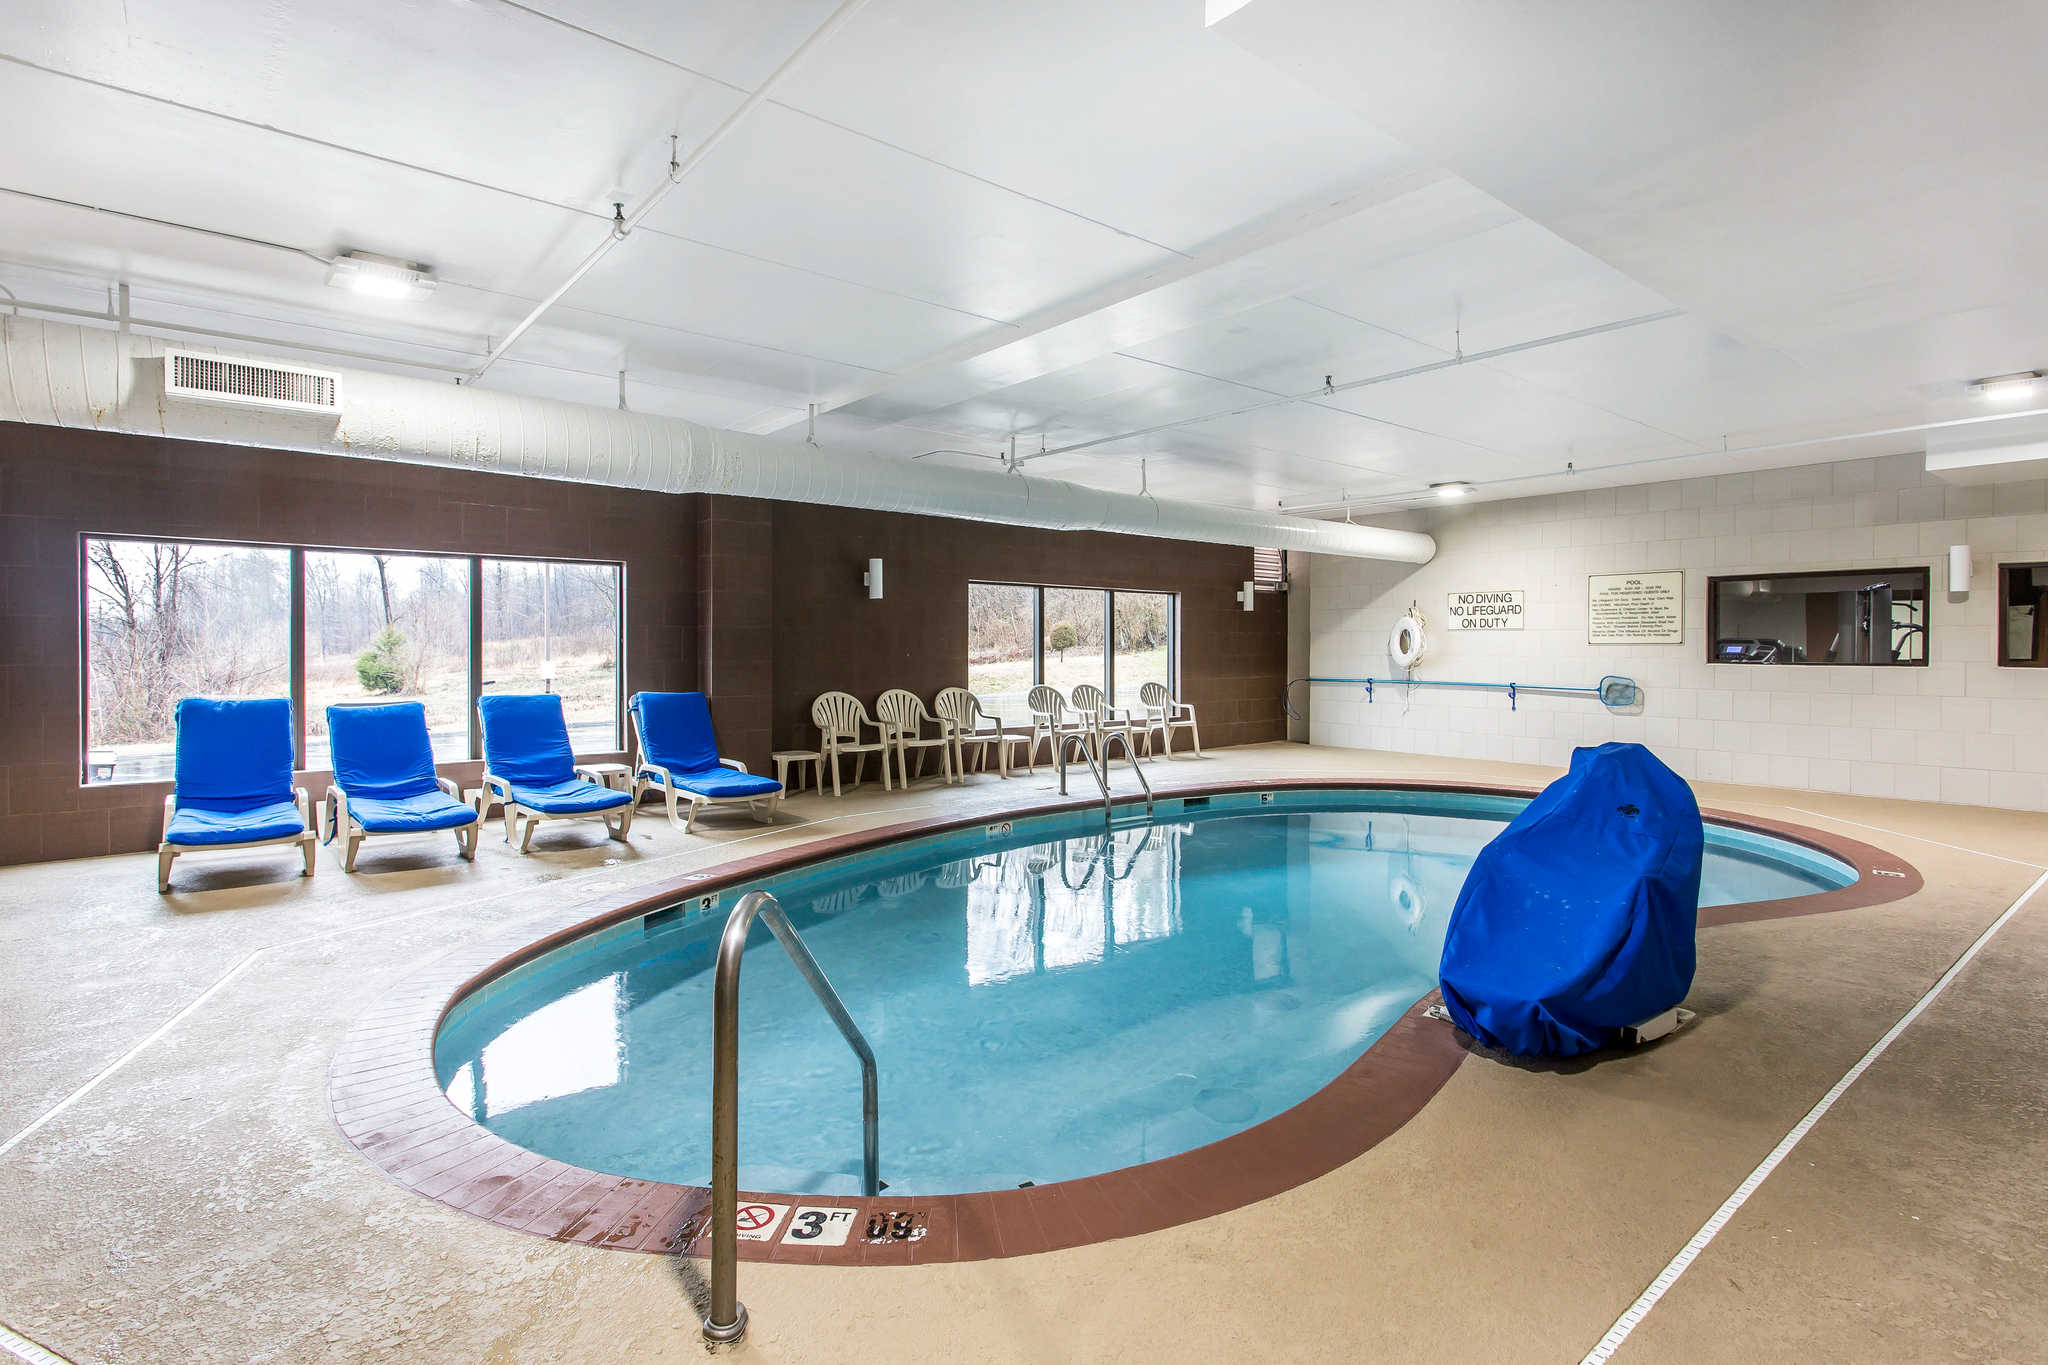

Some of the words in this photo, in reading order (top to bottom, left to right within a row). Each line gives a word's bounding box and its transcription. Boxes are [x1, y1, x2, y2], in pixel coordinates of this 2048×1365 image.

[1458, 594, 1475, 604] NO
[1476, 593, 1512, 604] DIVING
[1449, 606, 1464, 616] NO
[1466, 605, 1522, 615] LIFEGUARD
[1462, 618, 1477, 628] ON
[1479, 618, 1508, 628] DUTY
[791, 1211, 827, 1240] 3
[829, 1212, 852, 1222] FT
